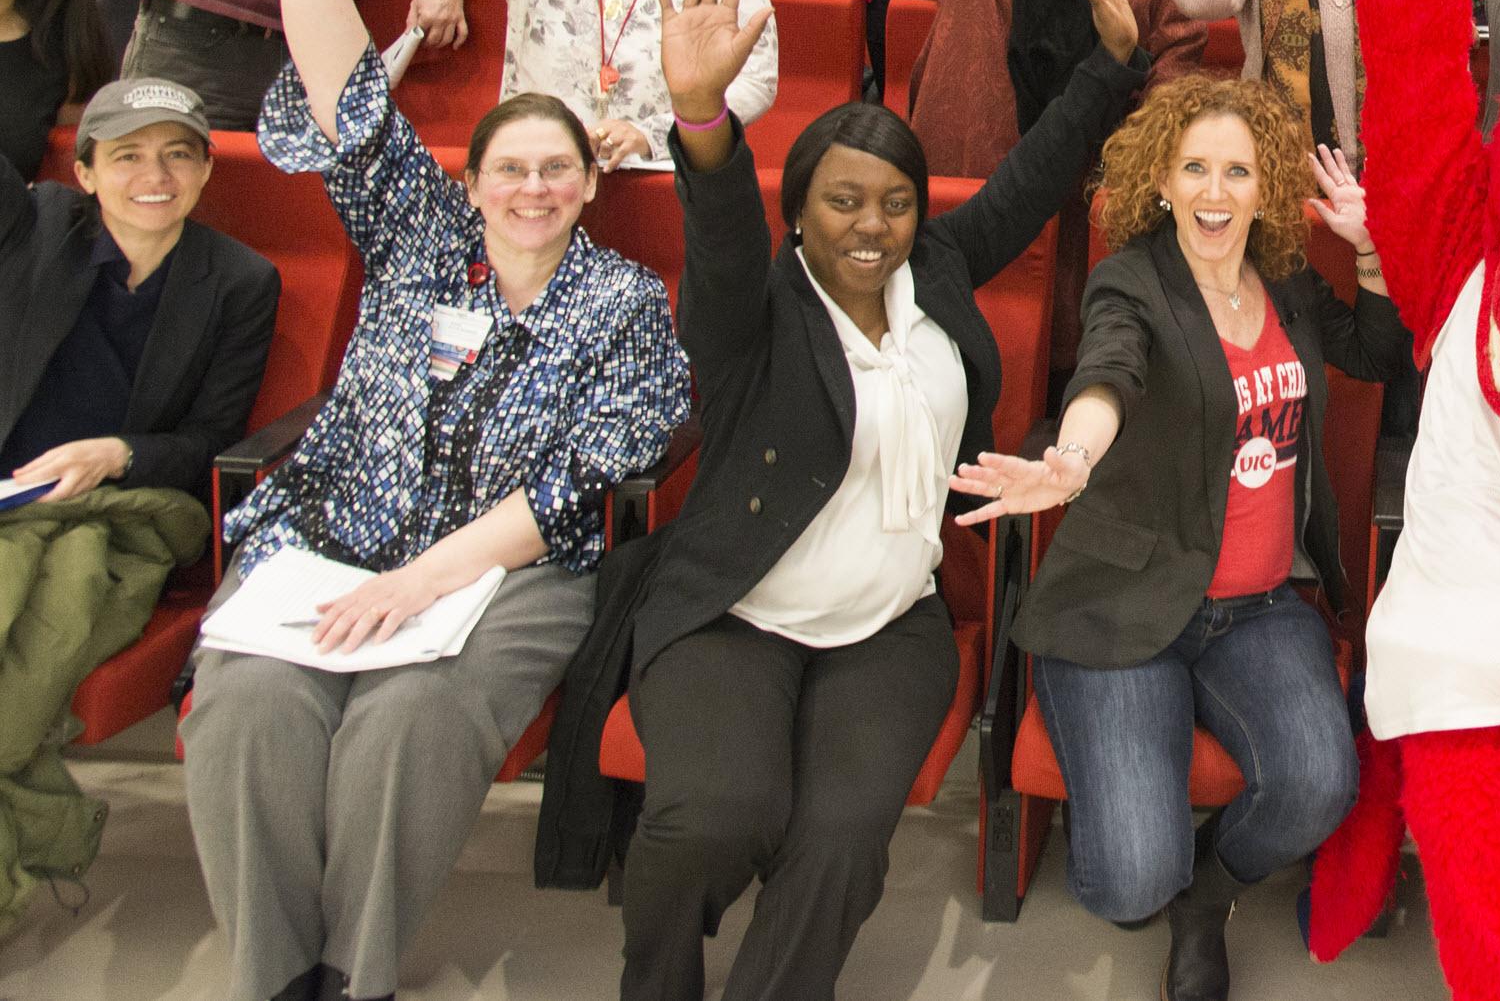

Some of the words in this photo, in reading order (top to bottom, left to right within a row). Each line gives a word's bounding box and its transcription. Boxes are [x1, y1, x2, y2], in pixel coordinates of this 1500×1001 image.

[1234, 376, 1252, 415] IS
[1254, 366, 1274, 406] AT
[1240, 455, 1272, 472] UIC
